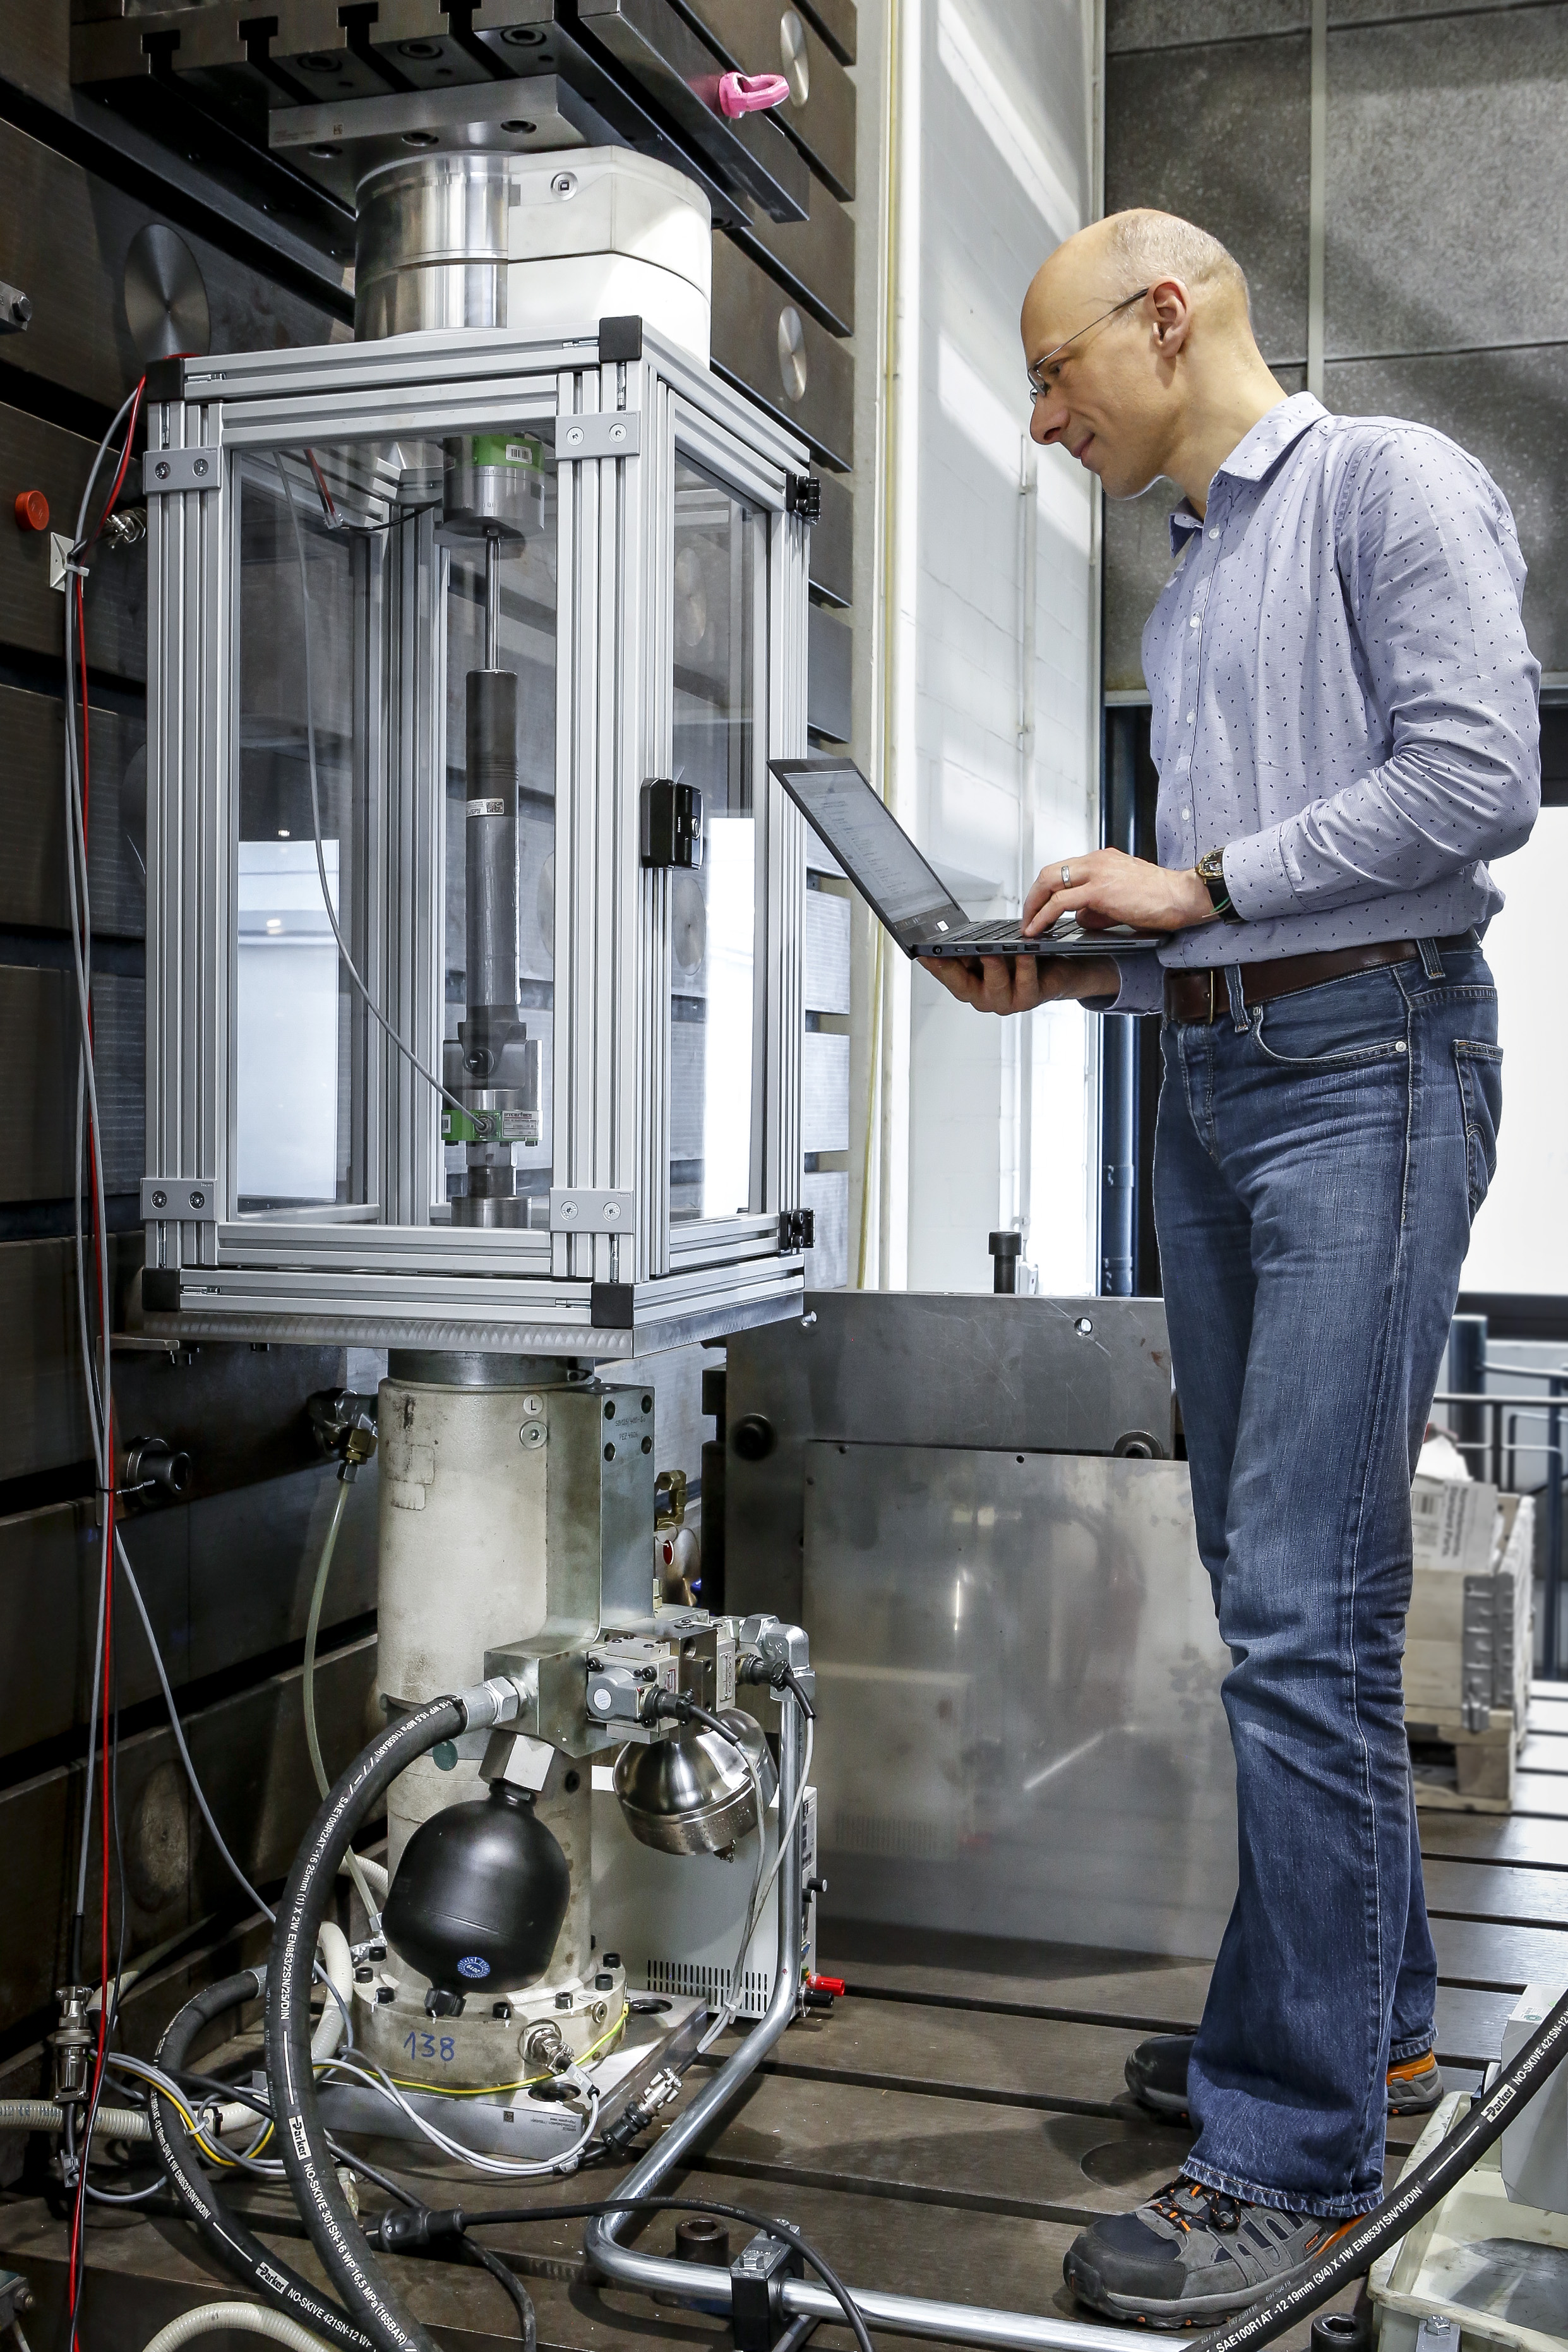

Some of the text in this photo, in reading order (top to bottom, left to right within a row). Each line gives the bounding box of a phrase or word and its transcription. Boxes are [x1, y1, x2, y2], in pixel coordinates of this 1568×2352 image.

[530, 1399, 537, 1411] L
[1446, 1486, 1458, 1529] Standard
[414, 1712, 430, 1724] 16,5
[429, 1704, 442, 1715] WP
[400, 1719, 418, 1732] MPa
[374, 1730, 405, 1758] (165BAR)
[280, 1796, 349, 2020] SAE100R2AT -16 25mm (1) X 2W EN853/2SN/25/DIN
[403, 2031, 455, 2061] 138
[1511, 2047, 1545, 2085] NO-SKIVE
[1540, 2015, 1568, 2052] 421SN-12
[1485, 2087, 1514, 2118] Parker
[291, 2116, 308, 2156] Parker
[169, 2160, 179, 2172] 1W
[303, 2161, 408, 2346] NO-SKIVE 301SN-16 WP 16,5 MPa (165BAR)
[1216, 2185, 1423, 2352] SAE100R1AT -12 19mm (3/4) X 1W EN853/1SN/19/DIN
[259, 2266, 285, 2291] Parker
[287, 2288, 325, 2319] NO-SKIVE
[323, 2313, 360, 2341] 421SN-12
